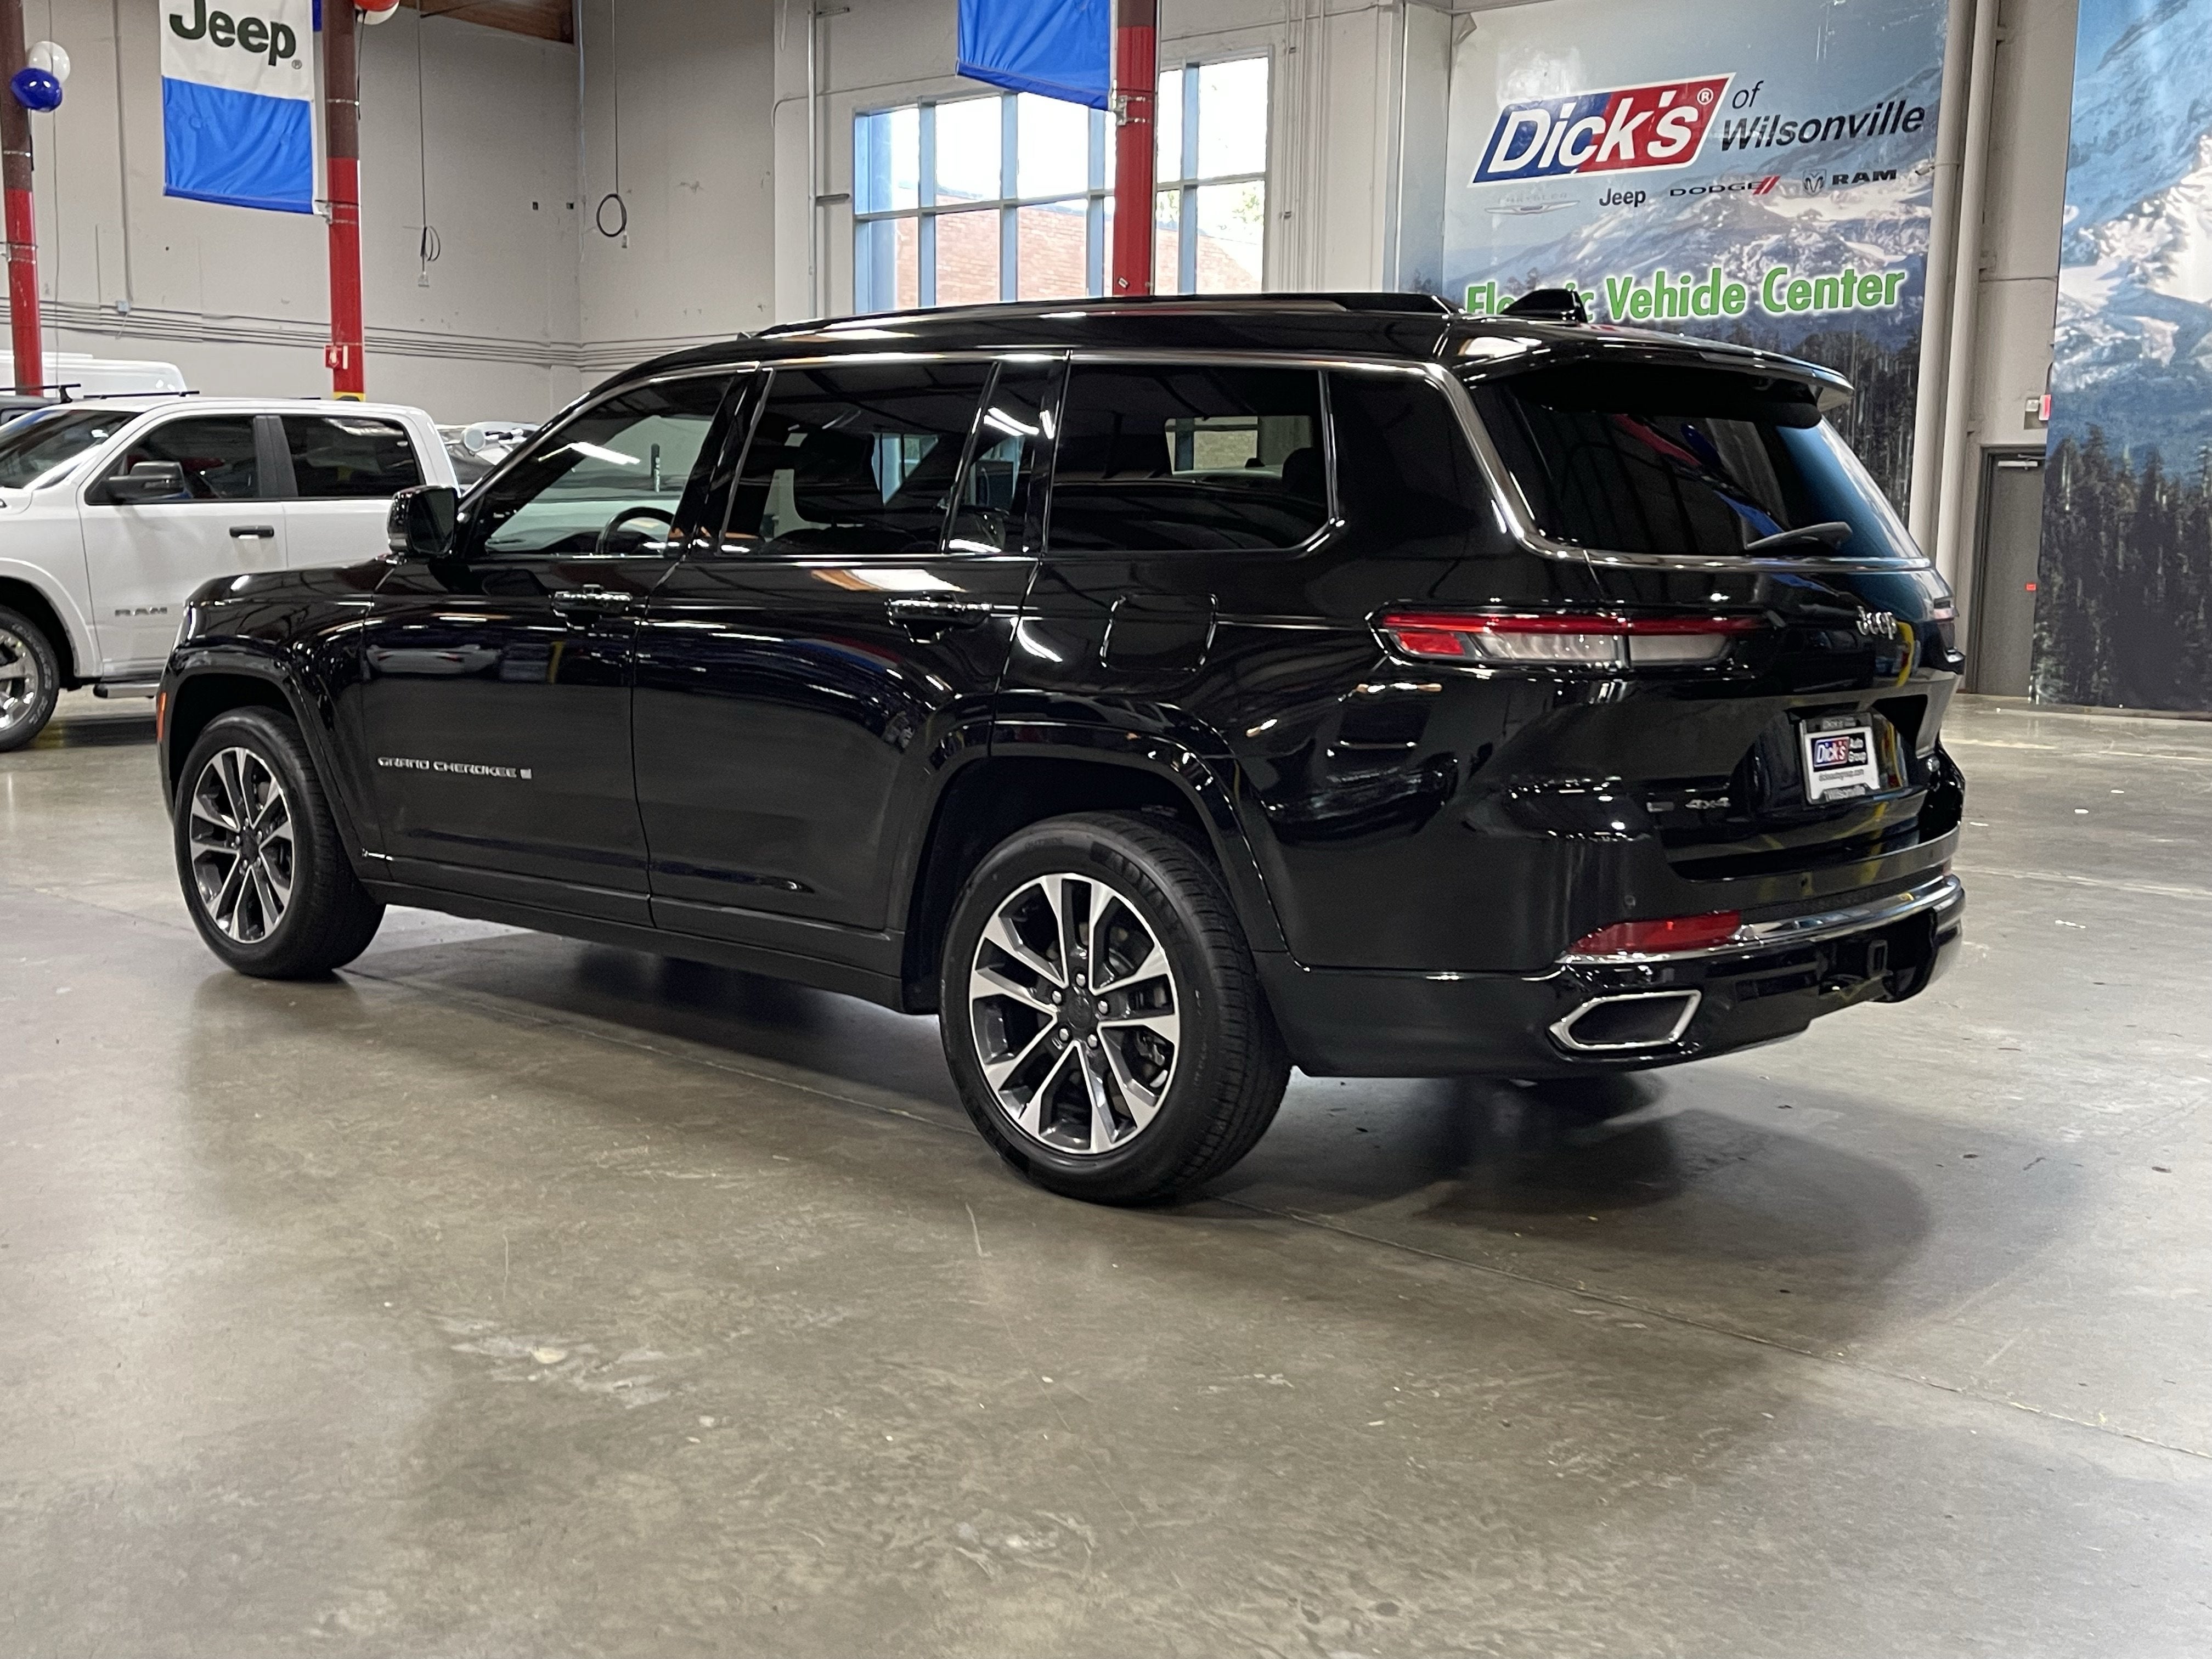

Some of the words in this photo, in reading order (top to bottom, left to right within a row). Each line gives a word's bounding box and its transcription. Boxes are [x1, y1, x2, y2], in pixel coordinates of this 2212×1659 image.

[169, 0, 296, 66] Jeep
[1732, 80, 1764, 109] of
[1721, 99, 1925, 151] Wilsonville
[1669, 180, 1764, 196] DODGE
[1832, 169, 1897, 185] RAM
[1599, 188, 1646, 207] Jeep
[1606, 268, 1746, 320] Vehicle
[1762, 267, 1905, 313] Center
[1855, 606, 1897, 640] Jeep
